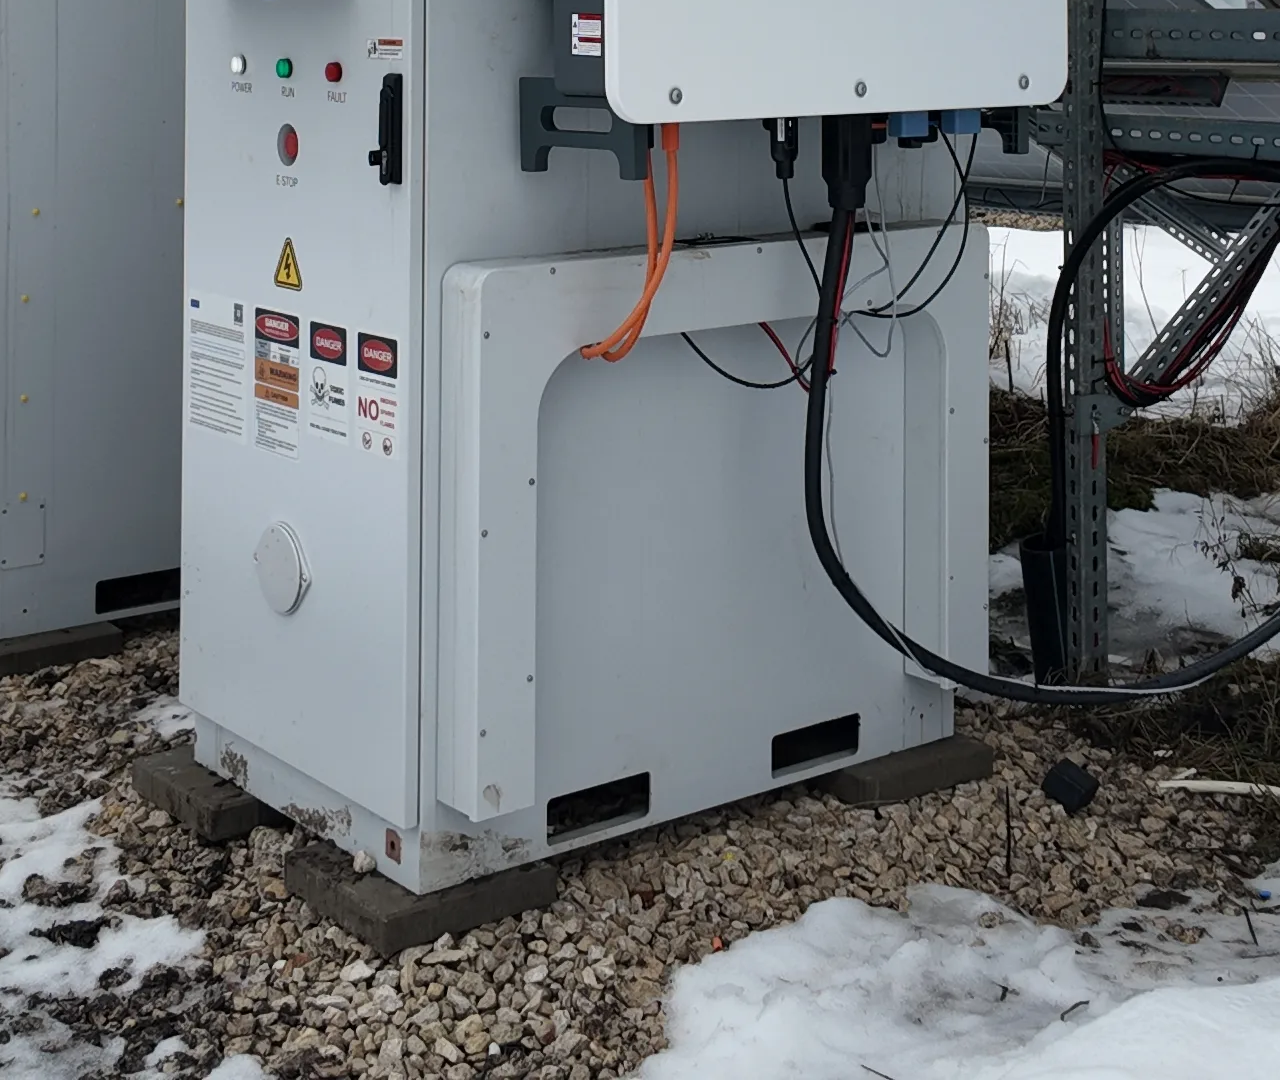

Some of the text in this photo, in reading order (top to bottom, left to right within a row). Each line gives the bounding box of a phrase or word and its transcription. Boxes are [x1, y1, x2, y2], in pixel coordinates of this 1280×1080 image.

[231, 81, 252, 93] POWER
[281, 86, 295, 98] RUN
[327, 91, 347, 103] FAULT
[264, 317, 289, 332] DANGER
[315, 336, 342, 352] DANGER
[363, 347, 392, 363] DANGER
[358, 396, 379, 421] NO
